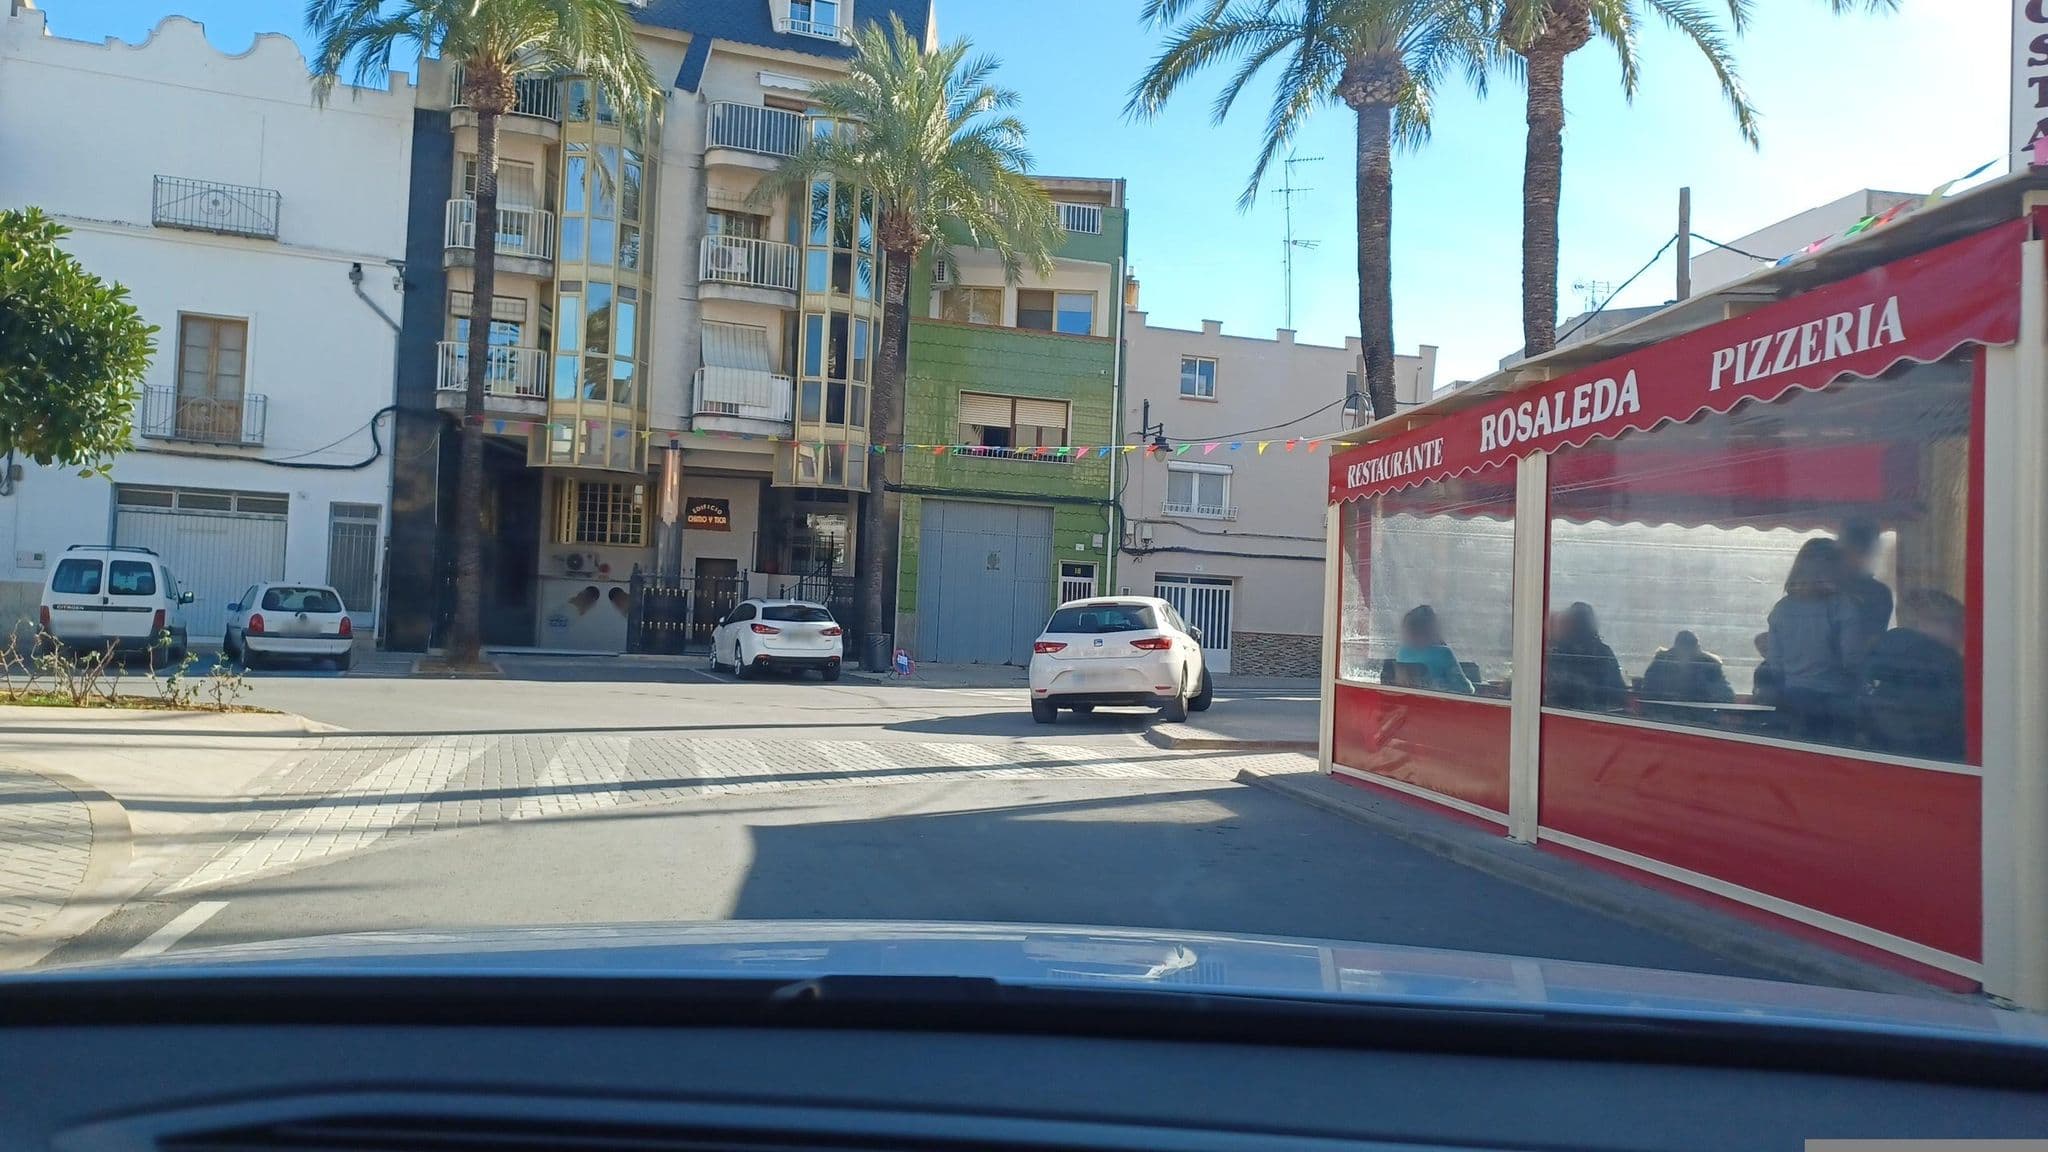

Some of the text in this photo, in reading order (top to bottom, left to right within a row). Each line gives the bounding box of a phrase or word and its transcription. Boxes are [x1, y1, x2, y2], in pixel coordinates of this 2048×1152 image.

[1709, 295, 1906, 393] PIZZERIA
[1479, 368, 1641, 453] ROSALEDA
[1346, 436, 1444, 490] RESTAURANTE
[692, 504, 723, 515] EDIFICIO
